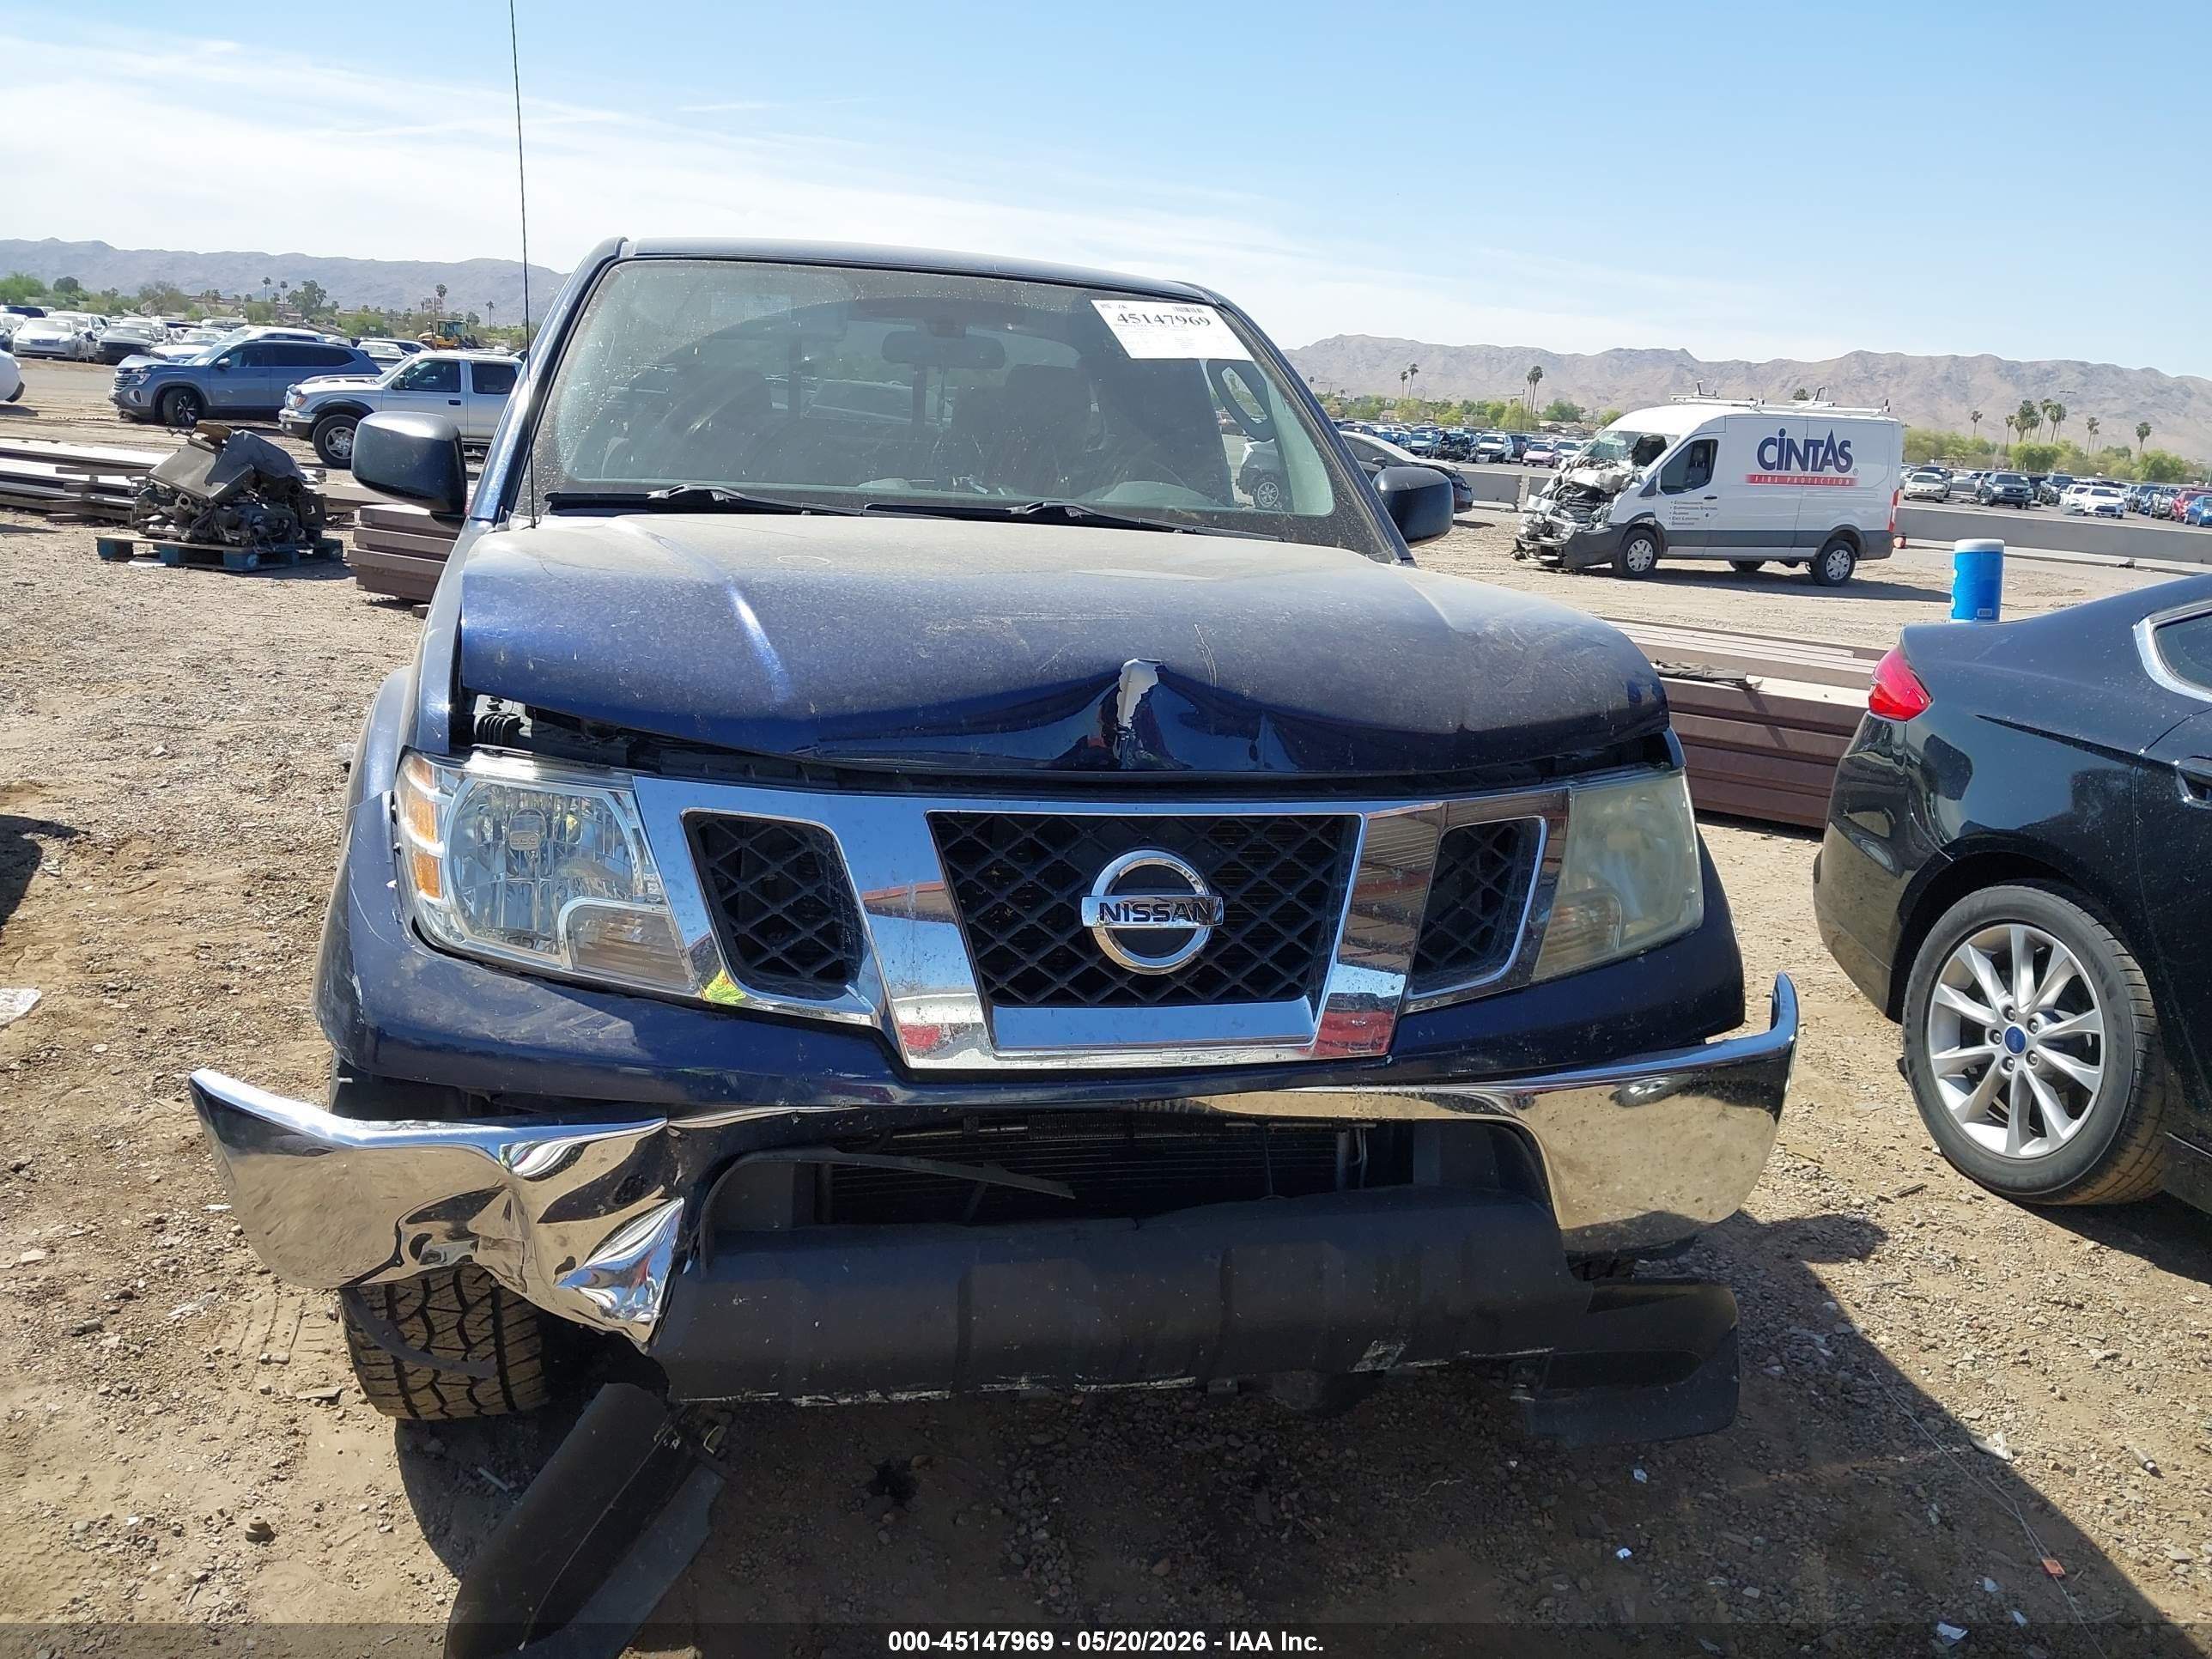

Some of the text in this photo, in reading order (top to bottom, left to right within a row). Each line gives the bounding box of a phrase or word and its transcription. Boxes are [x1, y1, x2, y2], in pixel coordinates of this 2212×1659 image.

[1117, 313, 1211, 327] 45147969
[1754, 475, 1850, 486] FIRE PROTECTION
[1099, 902, 1212, 923] NISSAN
